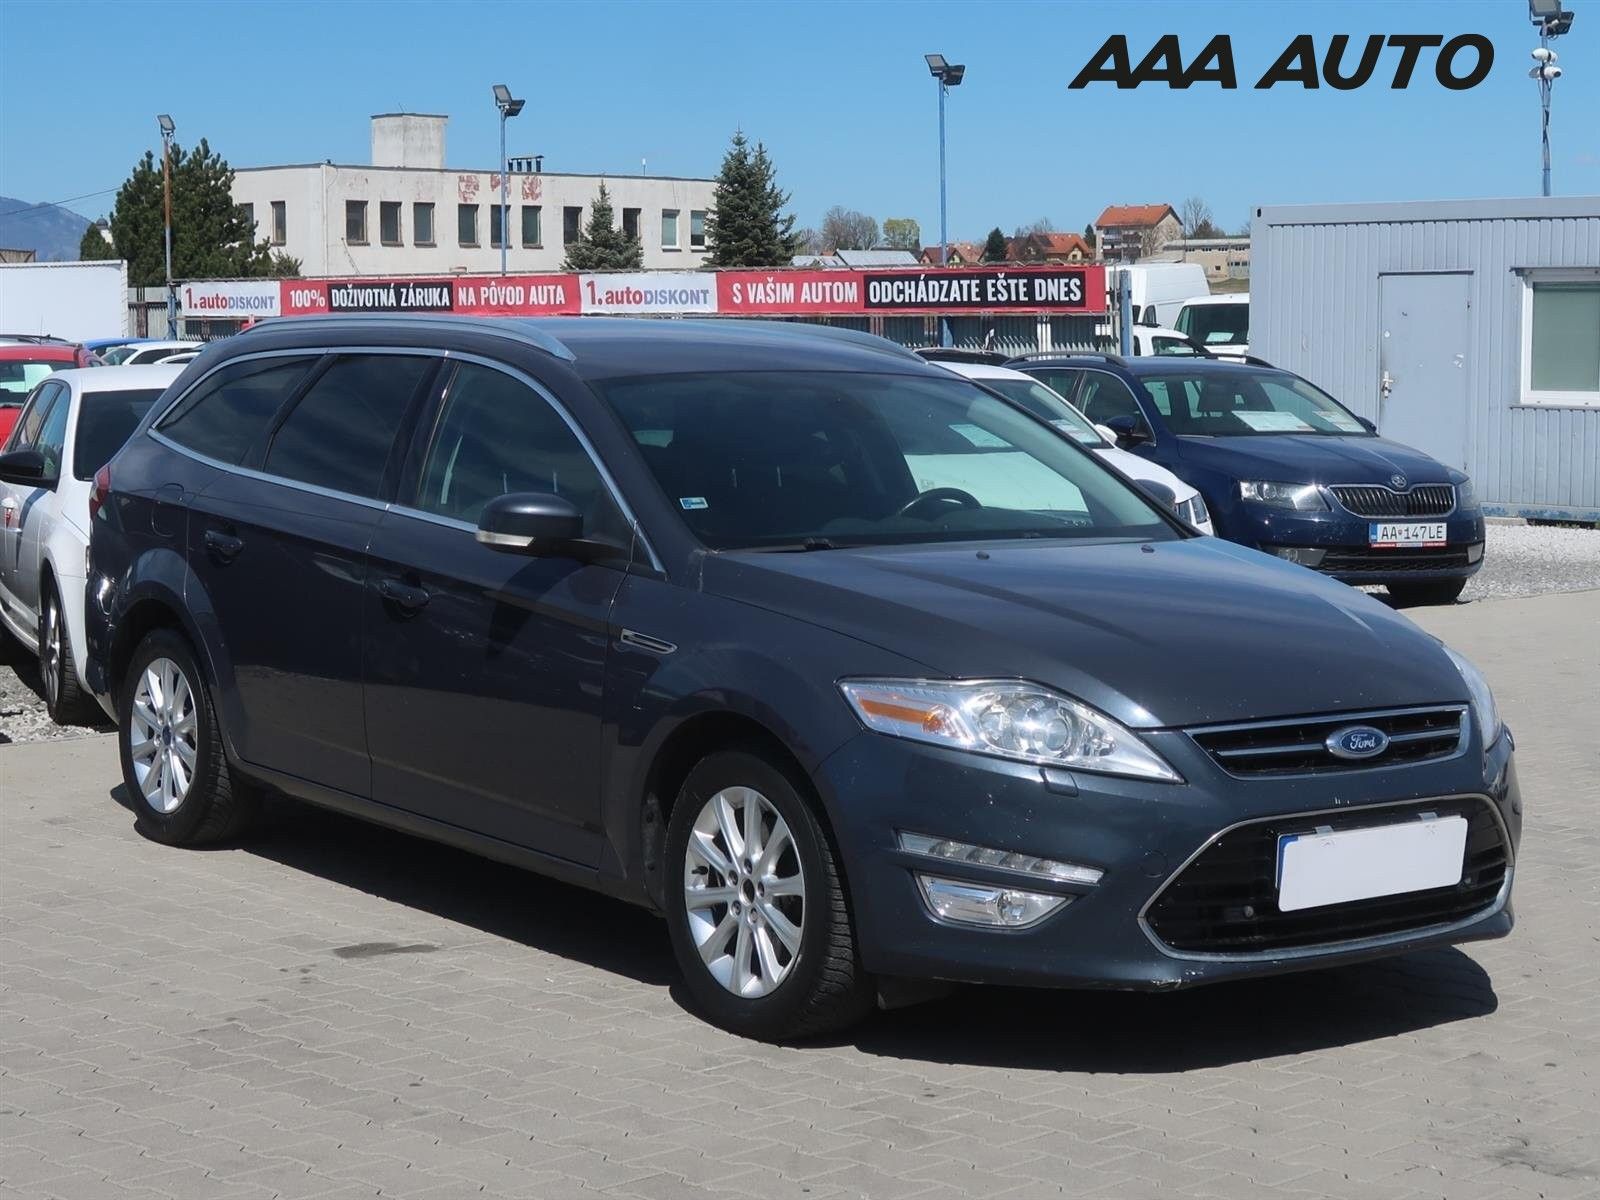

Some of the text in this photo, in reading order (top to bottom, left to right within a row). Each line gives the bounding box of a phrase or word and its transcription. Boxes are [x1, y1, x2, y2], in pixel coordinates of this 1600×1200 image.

[290, 281, 565, 308] 100% DOŽIVOTNÁ ZÁRUKA NA PÔVOD AUTA
[732, 273, 1081, 303] S VAŠIM AUTOM ODCHÁDZATE EŠTE DNES
[1350, 733, 1375, 749] Ford
